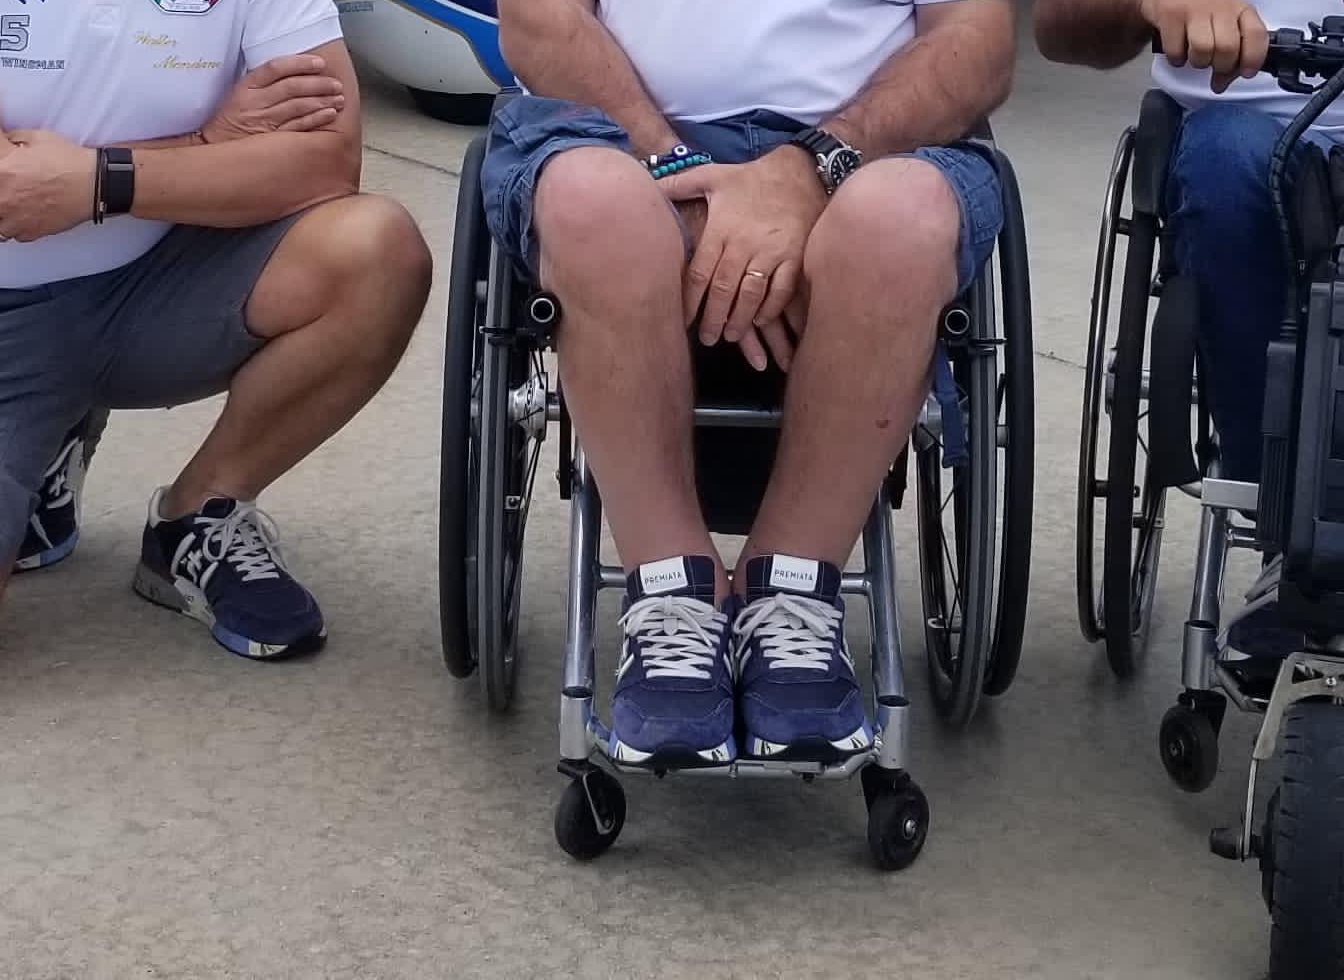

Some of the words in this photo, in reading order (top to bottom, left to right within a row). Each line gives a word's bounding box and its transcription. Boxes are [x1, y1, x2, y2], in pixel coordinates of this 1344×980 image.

[0, 15, 31, 52] 5
[644, 572, 683, 586] PREMIATA
[774, 569, 814, 582] PREMIATA
